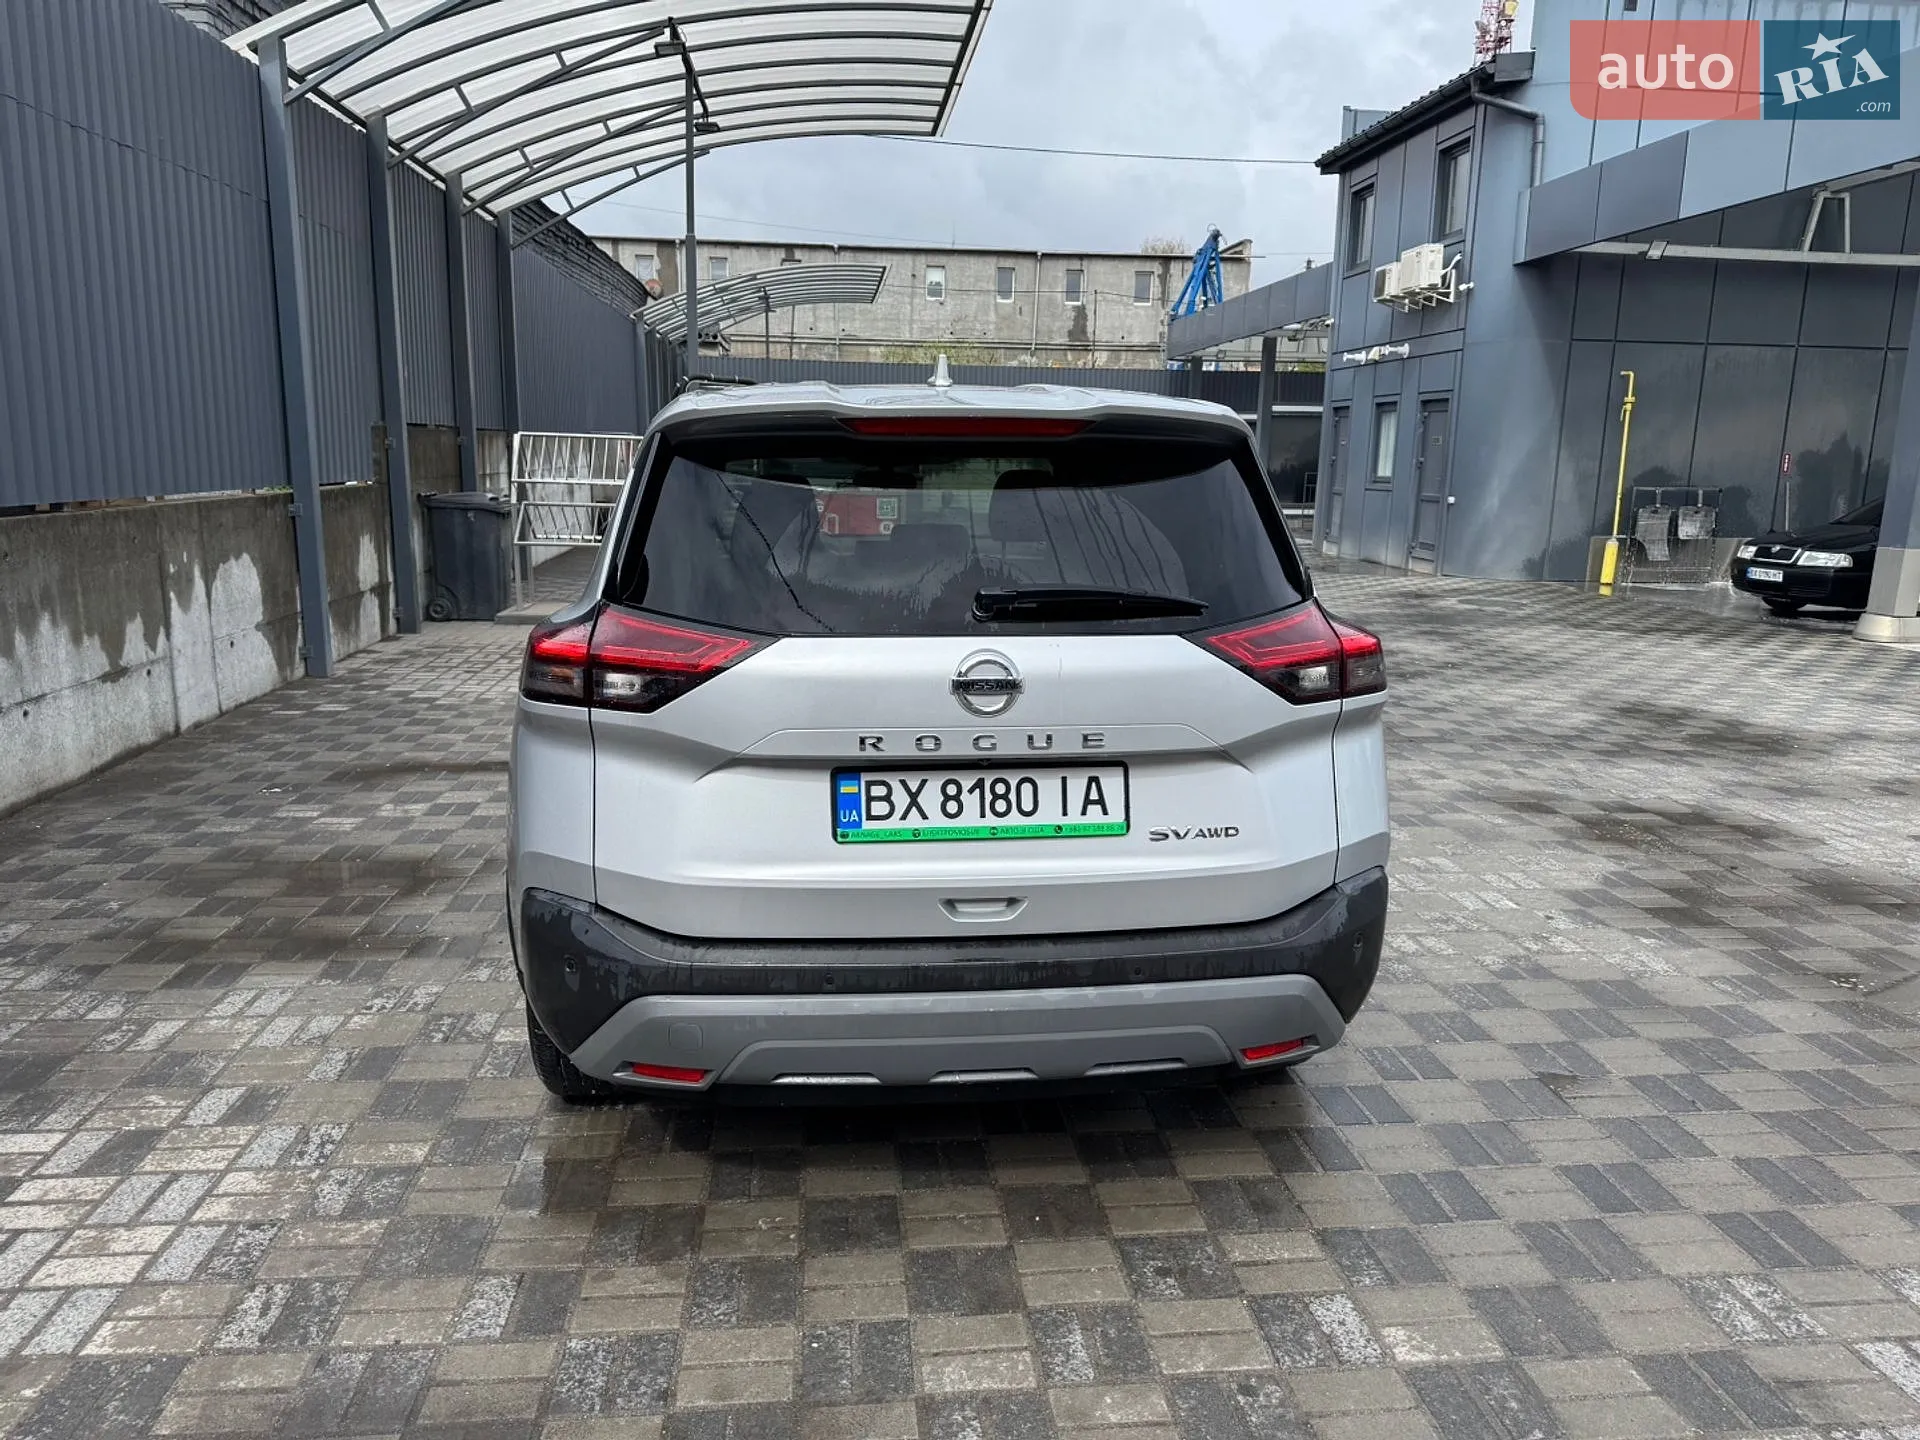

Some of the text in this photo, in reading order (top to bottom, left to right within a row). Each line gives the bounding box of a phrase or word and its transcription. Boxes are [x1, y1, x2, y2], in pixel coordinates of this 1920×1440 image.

[959, 680, 1018, 691] NISSAN
[858, 732, 1106, 752] ROGUE
[864, 775, 1110, 822] BX 8180 IA
[840, 811, 859, 823] UA
[1148, 825, 1239, 842] SV AWD
